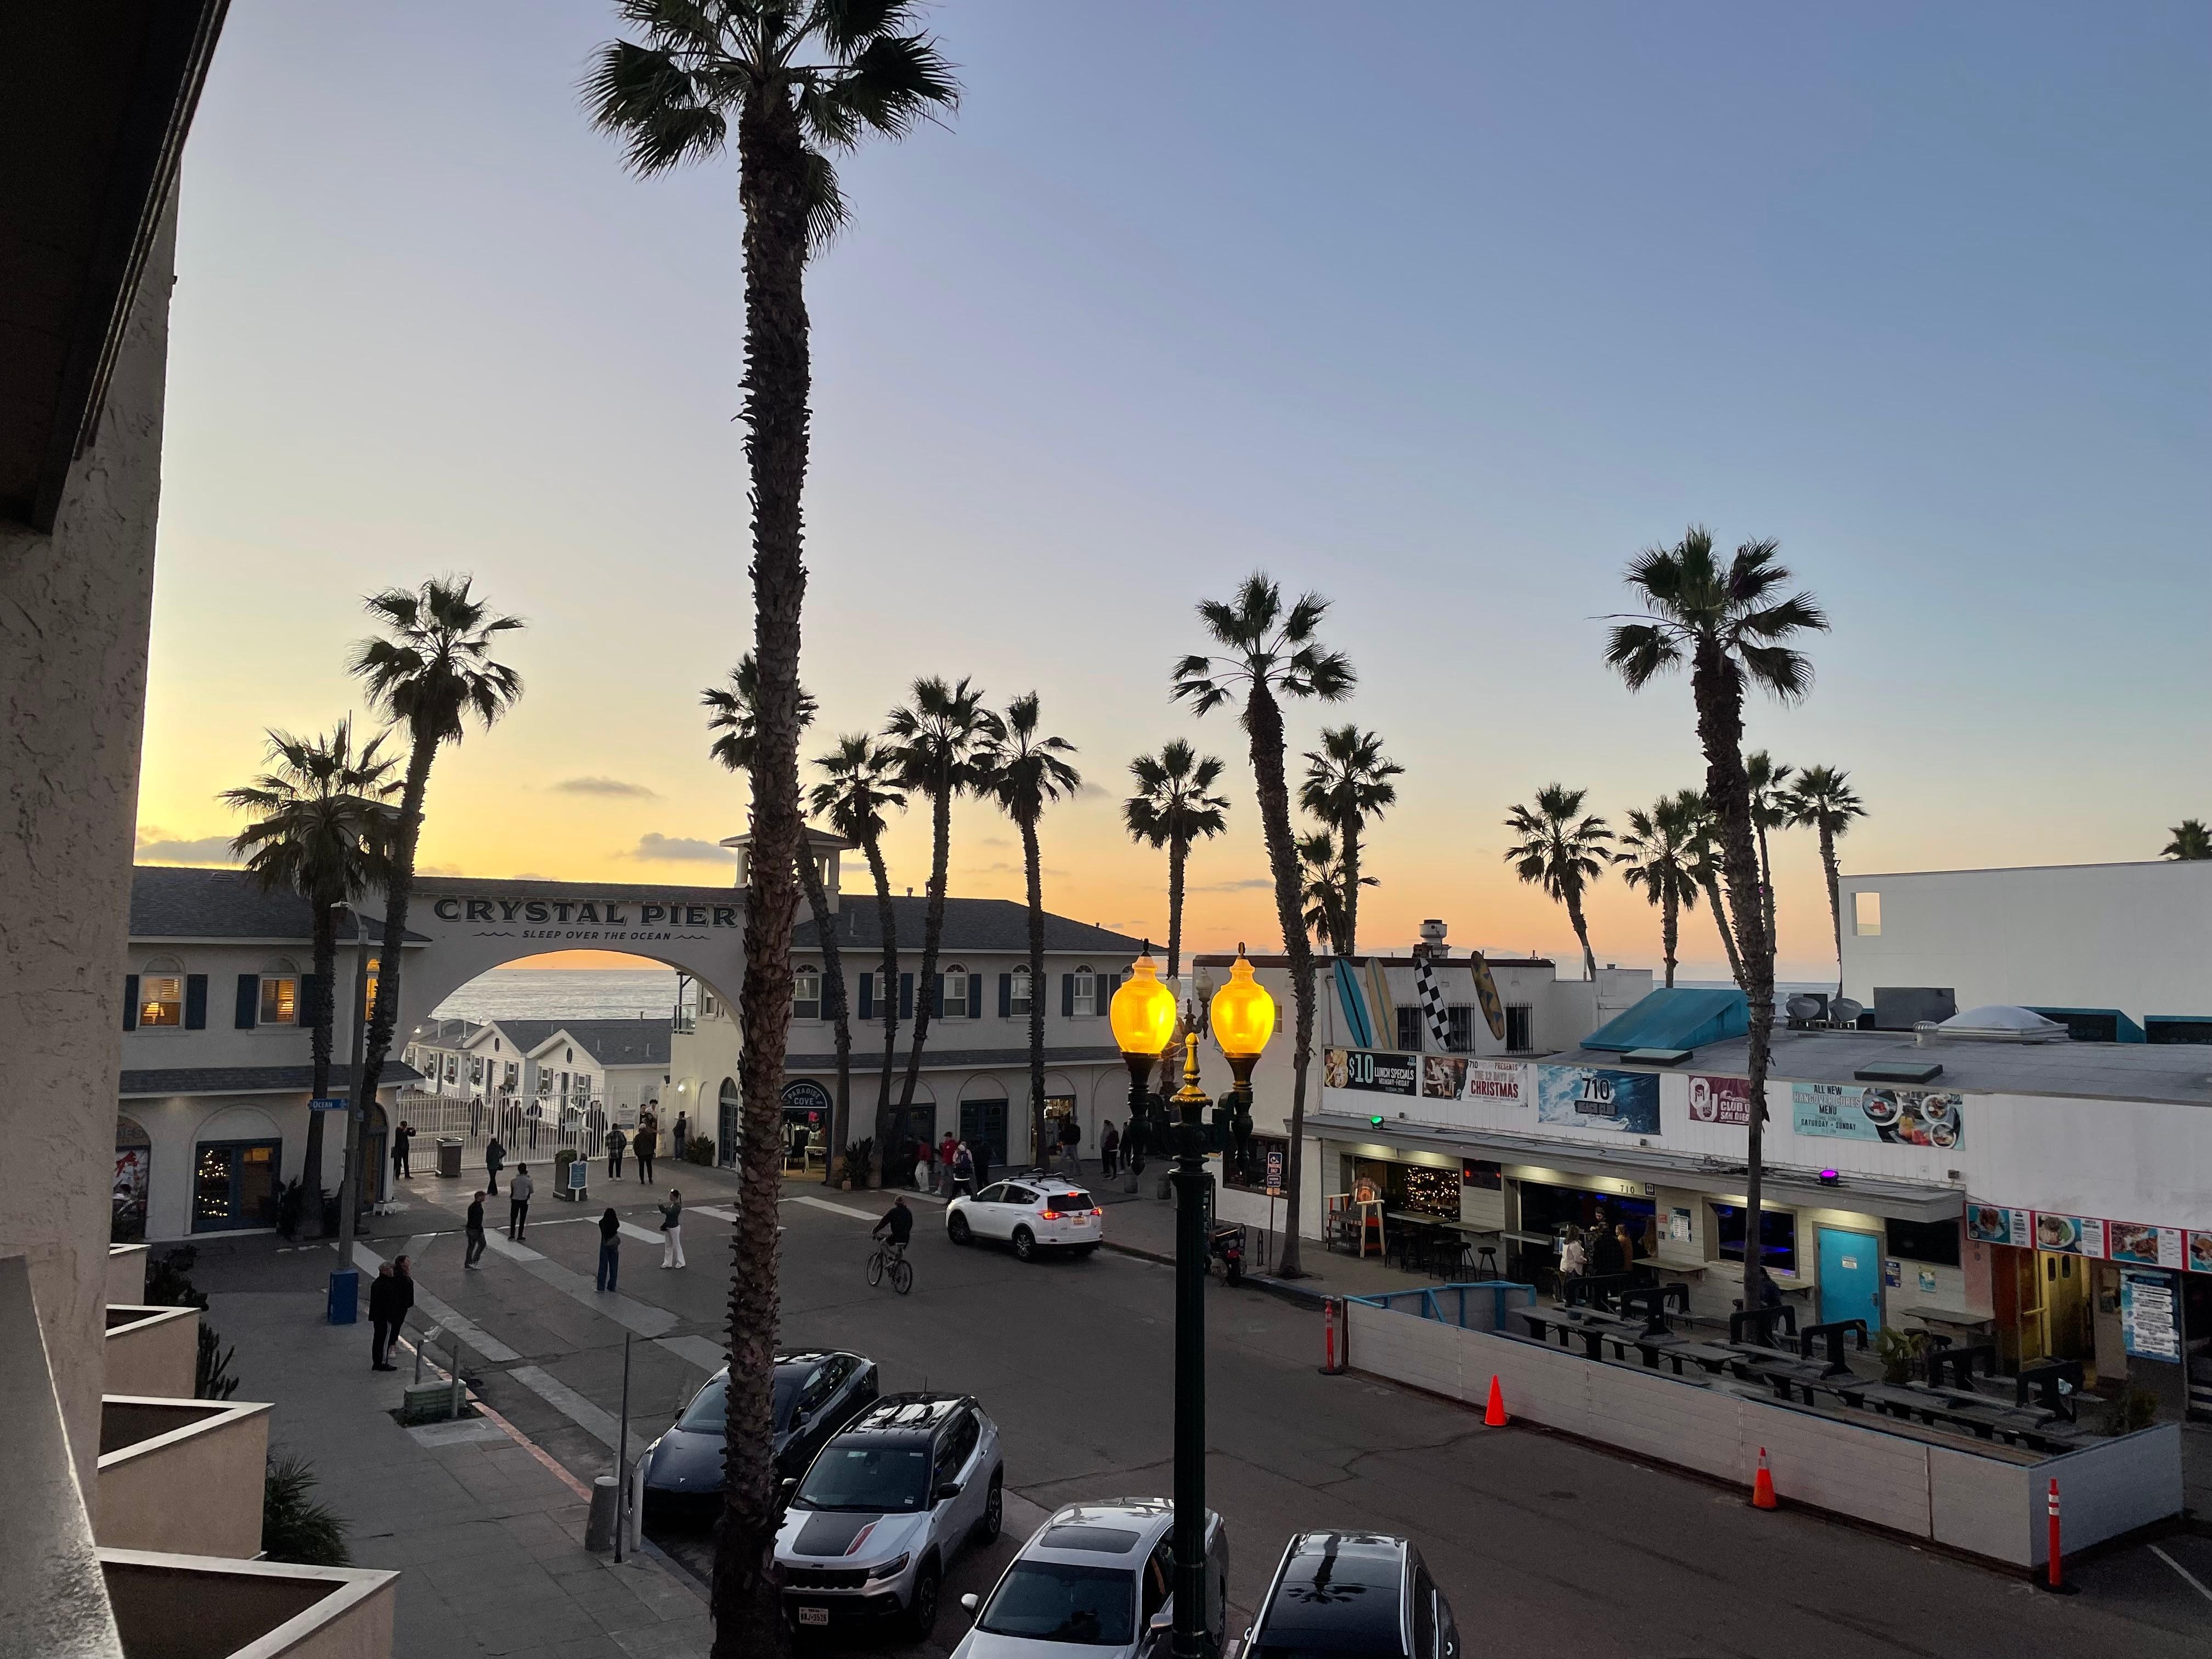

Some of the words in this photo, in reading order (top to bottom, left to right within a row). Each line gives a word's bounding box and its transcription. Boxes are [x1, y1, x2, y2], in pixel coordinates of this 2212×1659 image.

[434, 899, 627, 926] CRYSTAL
[640, 906, 738, 929] PIER
[522, 930, 561, 939] SLEEP
[566, 931, 599, 940] OVER
[1349, 1054, 1374, 1084] $10
[1469, 1060, 1478, 1069] 710
[1494, 1062, 1519, 1071] PRESENTS
[1374, 1066, 1390, 1078] LUNCH
[1391, 1069, 1414, 1080] SPECIALS
[787, 1088, 821, 1099] PARADISE
[1471, 1080, 1519, 1098] CHRISTMAS
[1582, 1077, 1610, 1101] 710
[1814, 1085, 1825, 1094] ALL
[1827, 1086, 1842, 1096] NEW
[794, 1097, 814, 1105] COVE
[1793, 1091, 1835, 1105] HANGOVER
[1836, 1096, 1861, 1108] CURES
[1720, 1101, 1743, 1112] CLUB
[1819, 1105, 1837, 1115] MENU
[1720, 1111, 1733, 1120] SAN
[1801, 1119, 1829, 1128] SATURDAY
[1836, 1122, 1856, 1131] SUNDAY
[1620, 1185, 1635, 1194] 710
